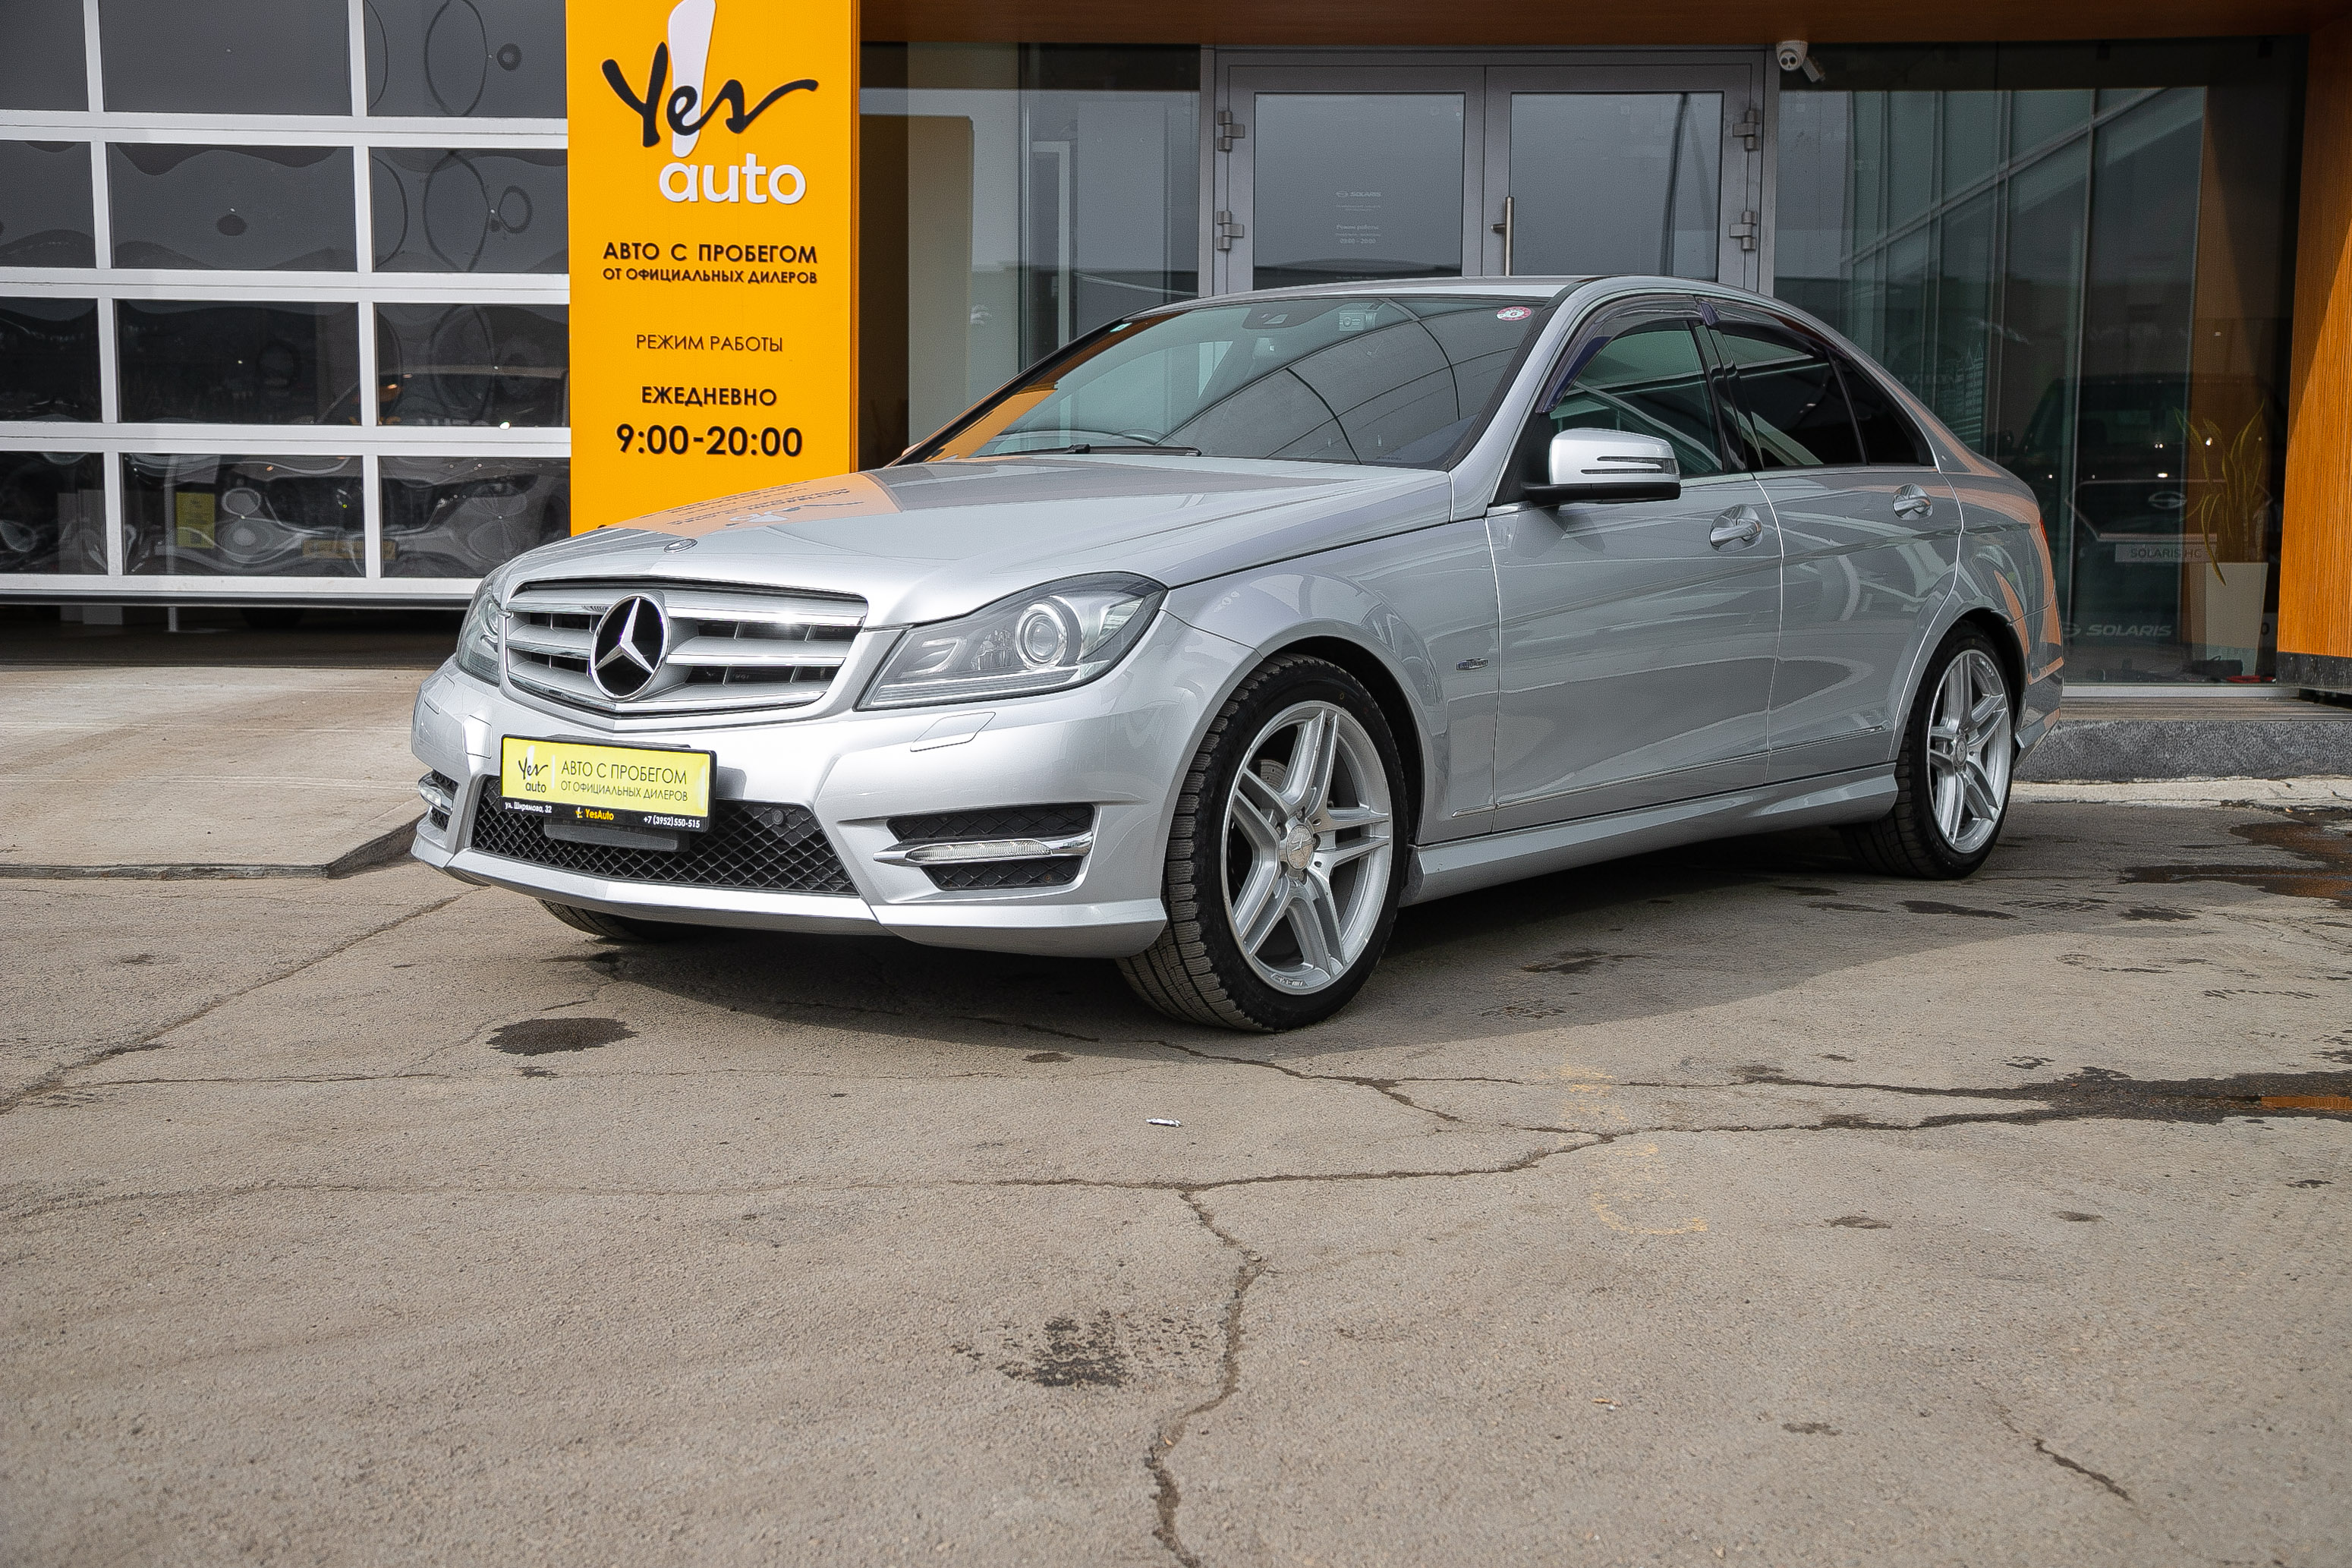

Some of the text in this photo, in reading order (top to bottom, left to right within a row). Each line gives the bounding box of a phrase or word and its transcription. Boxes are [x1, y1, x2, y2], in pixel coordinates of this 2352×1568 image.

[601, 41, 819, 147] Yes
[659, 153, 807, 204] auto
[603, 242, 818, 264] АВТО С ПРОБЕГОМ
[603, 268, 818, 284] ОТ ОФИЦИАЛЬНЫХ ДИЛЕРОВ
[636, 334, 783, 352] РЕЖИМ РАБОТЫ
[641, 386, 777, 407] ЕЖЕДНЕВНО
[616, 423, 803, 457] 9:00-20:00
[2086, 624, 2173, 638] SOLARIS
[561, 760, 687, 785] АВТО С ПРОБЕГОМ
[525, 781, 546, 793] auto
[561, 780, 688, 801] ОТ ОФИЦИАЛЬНЫХ ДИЛЕРОВ
[545, 805, 553, 814] 32
[585, 808, 615, 820] YesAuto
